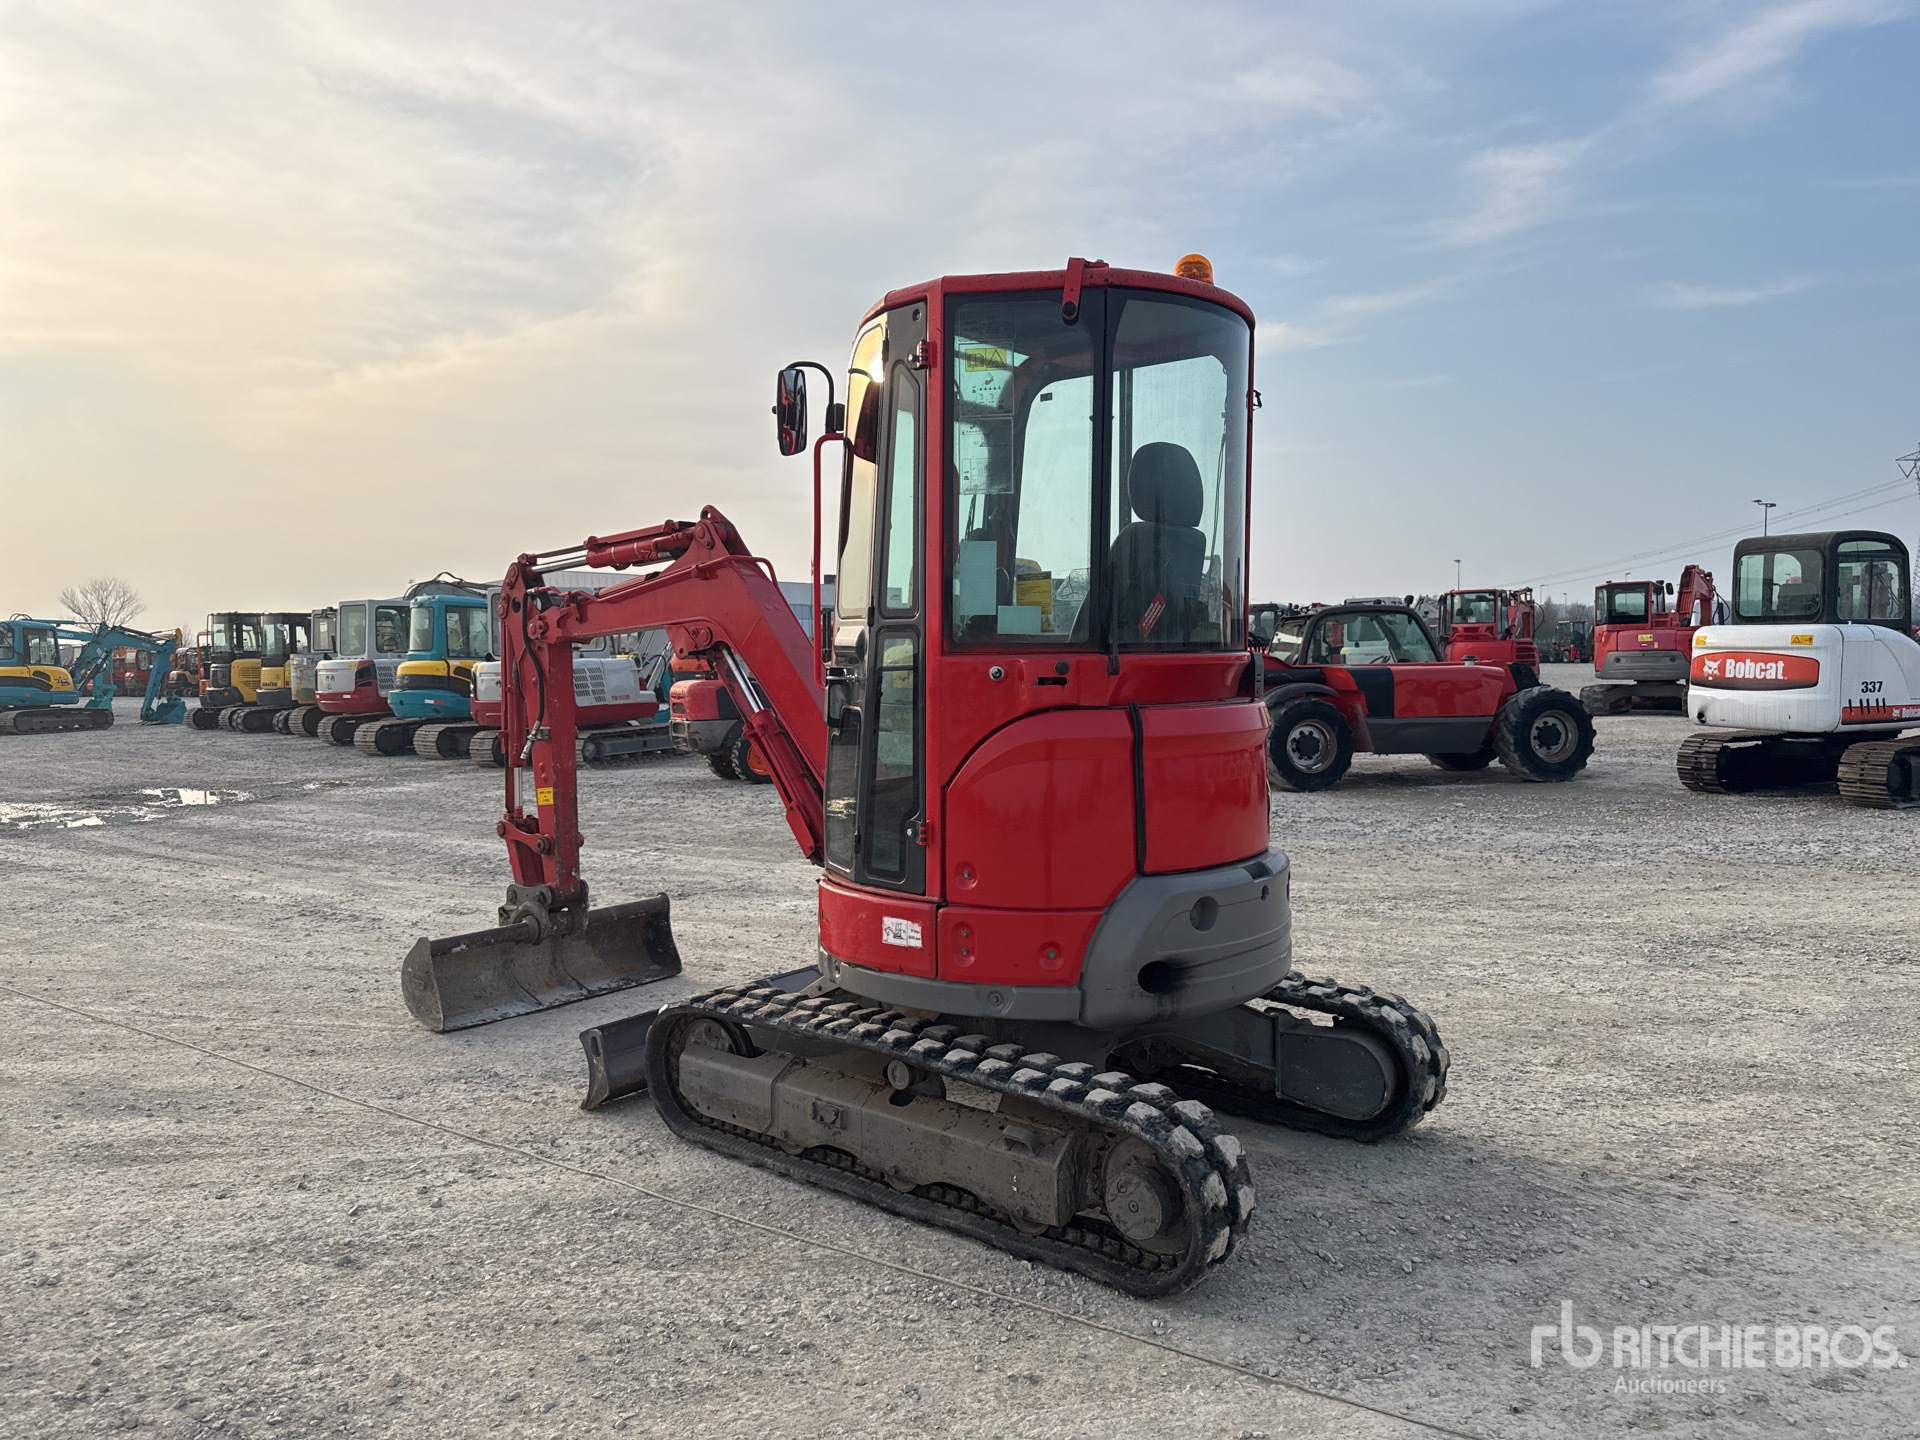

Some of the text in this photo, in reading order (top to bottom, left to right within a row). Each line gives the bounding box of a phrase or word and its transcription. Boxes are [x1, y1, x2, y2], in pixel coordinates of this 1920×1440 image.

[1725, 658, 1784, 680] Bobcat
[1861, 681, 1883, 693] 337
[1901, 706, 1920, 718] Bobca
